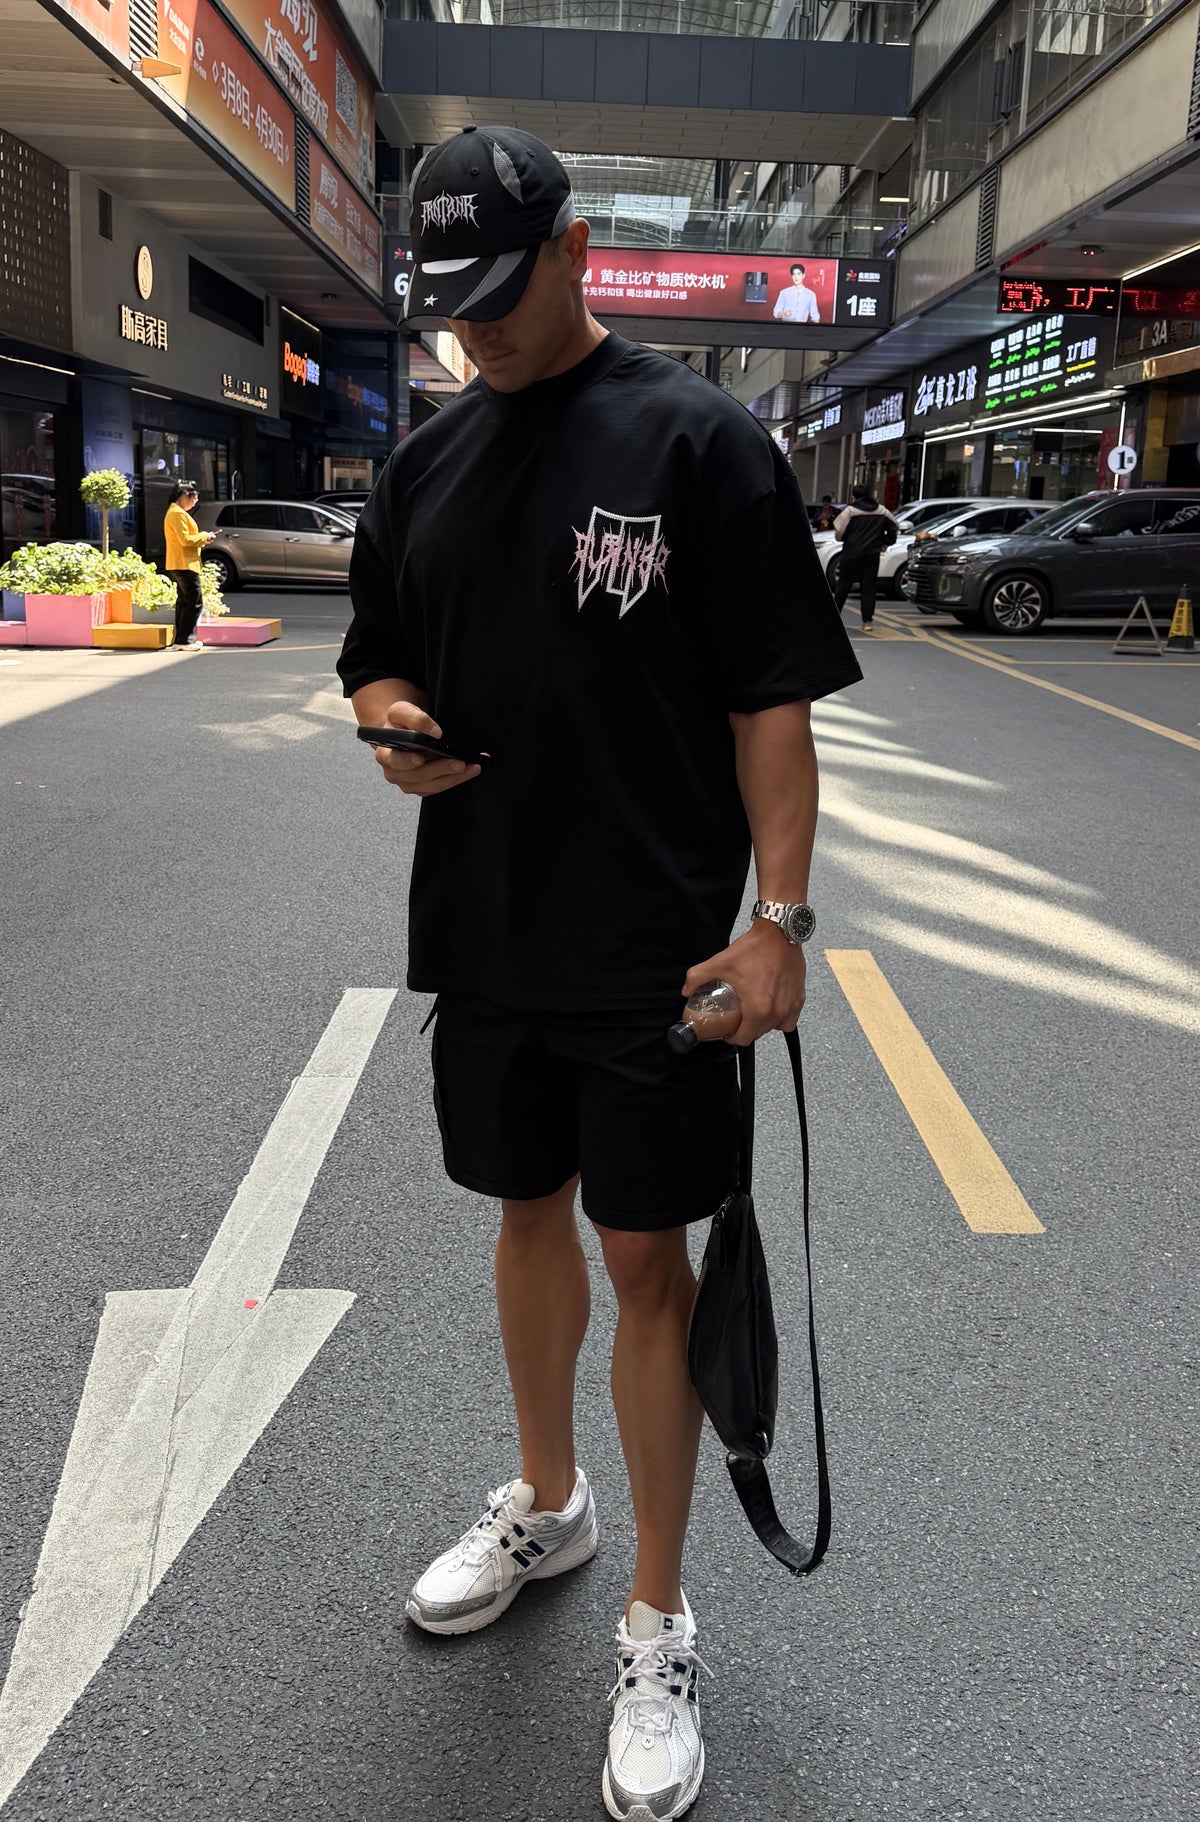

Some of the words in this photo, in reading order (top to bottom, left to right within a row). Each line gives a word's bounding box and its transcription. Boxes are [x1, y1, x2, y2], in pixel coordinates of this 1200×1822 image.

[600, 268, 726, 290] 黄金比矿物质饮水机
[846, 294, 878, 317] 1座
[121, 304, 169, 351] 斯高家具
